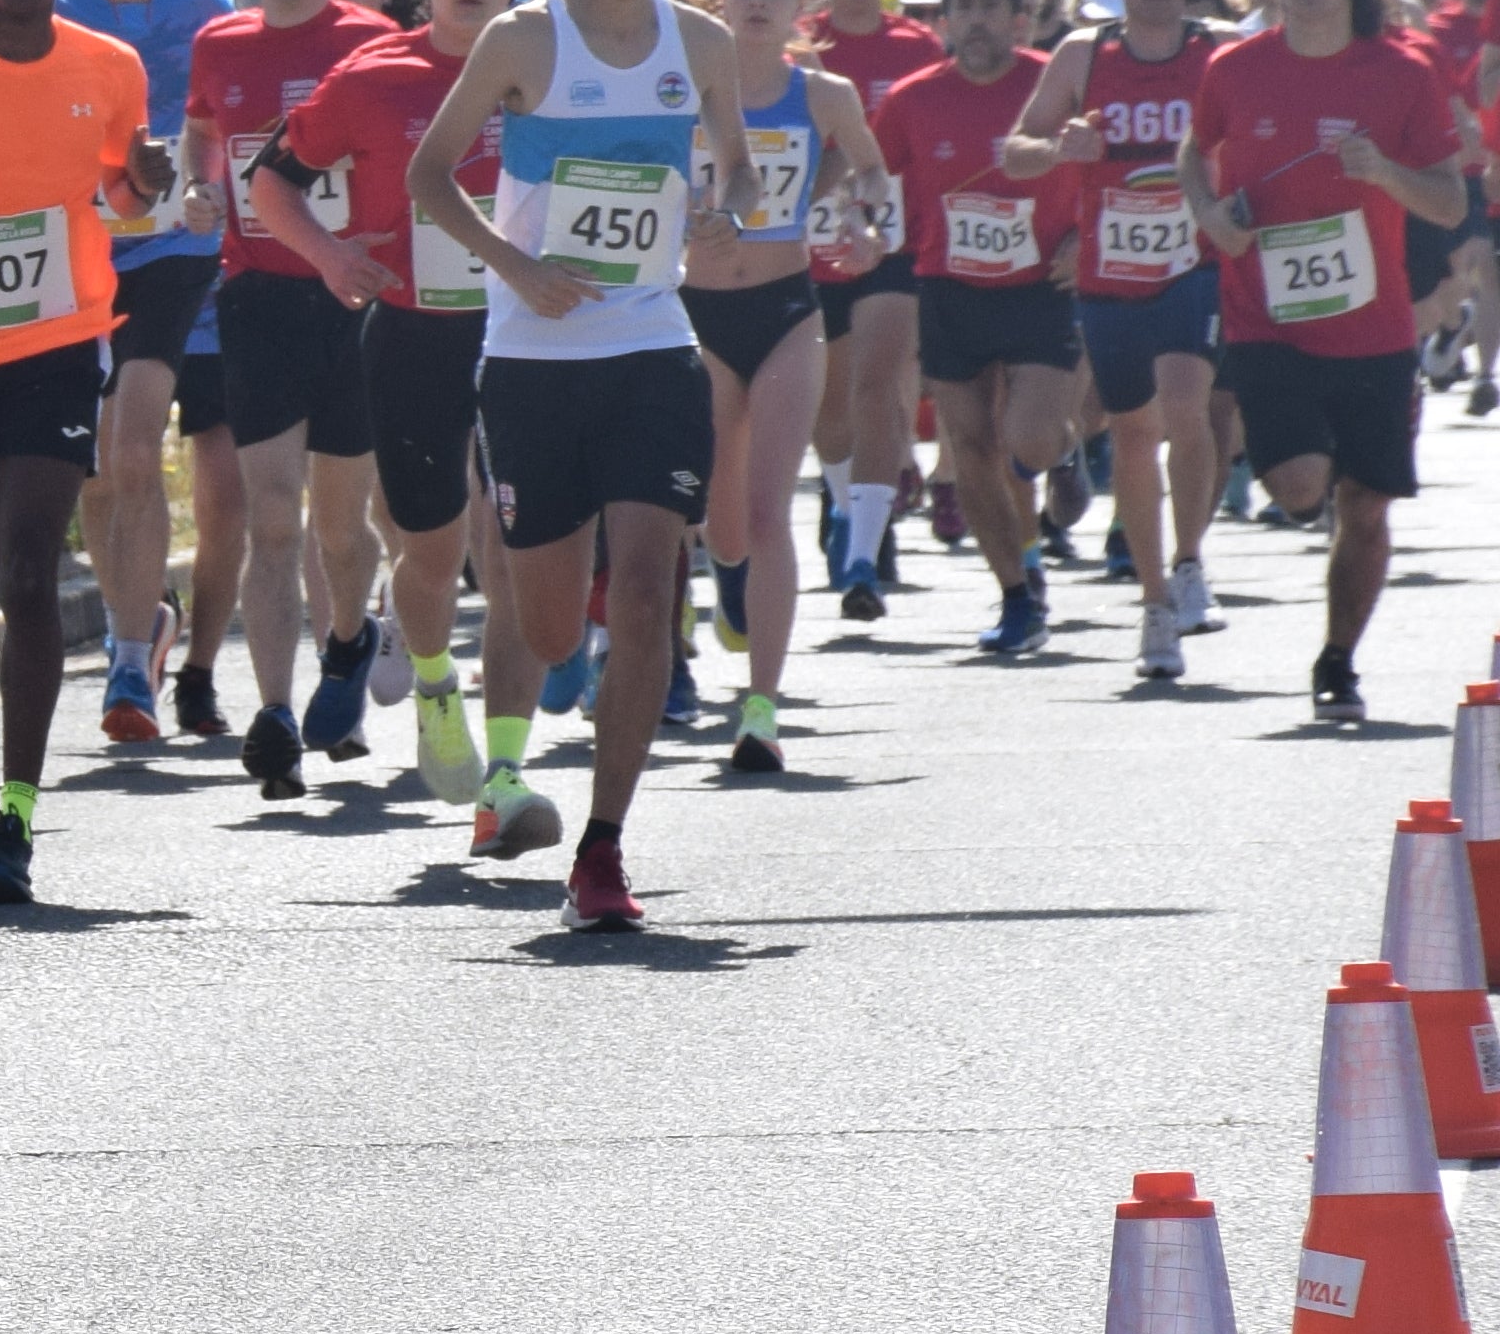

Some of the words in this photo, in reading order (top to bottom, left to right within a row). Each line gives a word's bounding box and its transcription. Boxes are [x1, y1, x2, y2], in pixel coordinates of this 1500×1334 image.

[1104, 99, 1192, 144] 360
[571, 205, 659, 251] 450
[956, 220, 1028, 253] 1605
[1283, 249, 1356, 291] 261
